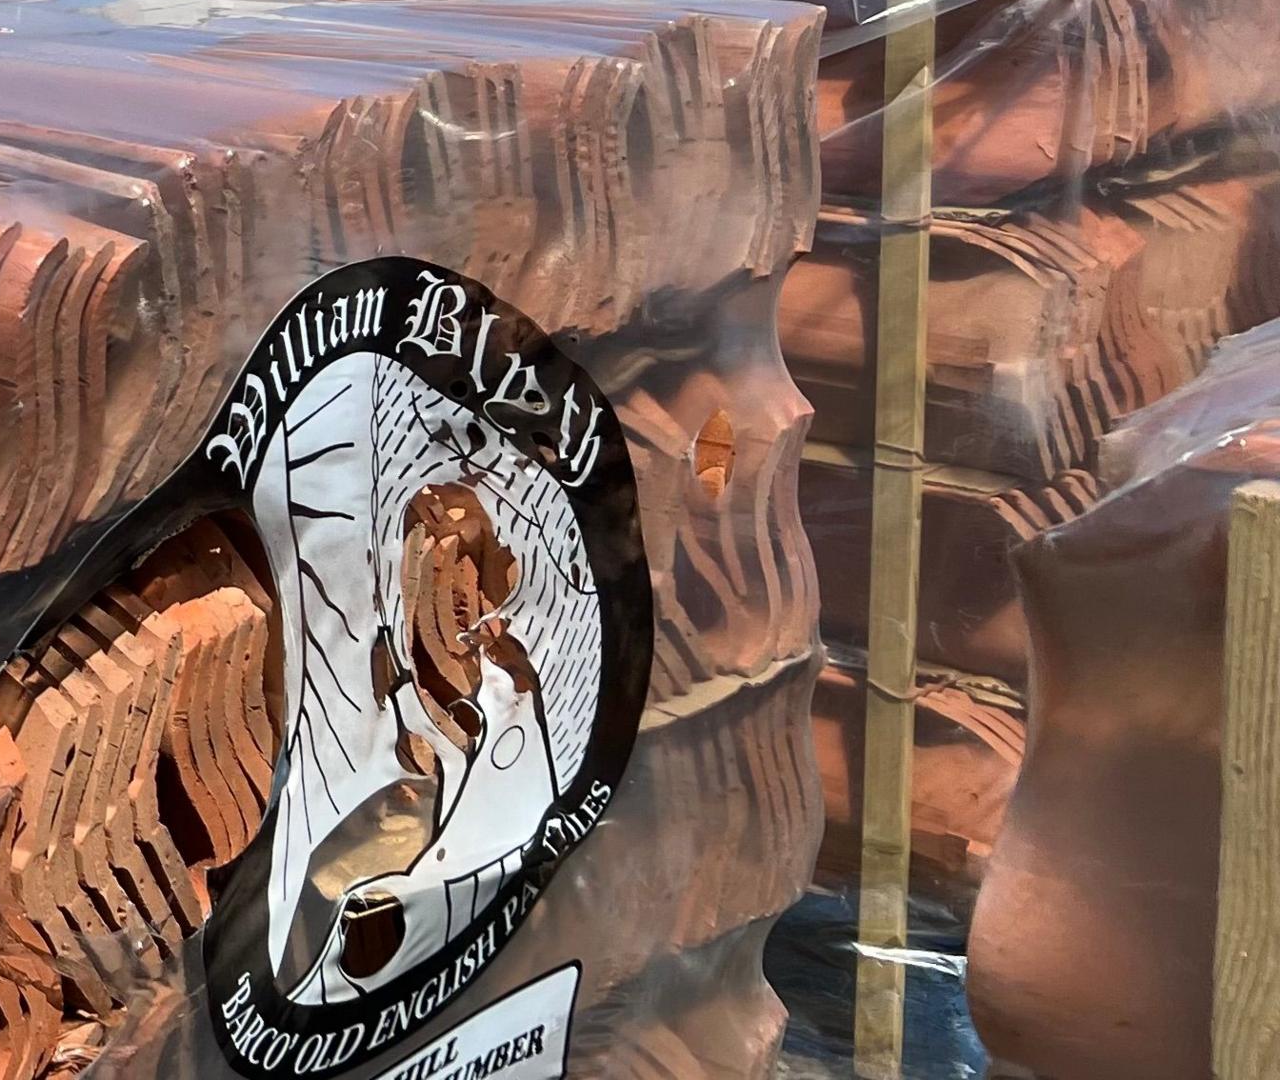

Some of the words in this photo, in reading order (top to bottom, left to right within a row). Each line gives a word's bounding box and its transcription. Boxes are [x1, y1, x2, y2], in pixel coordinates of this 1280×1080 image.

[206, 286, 389, 490] William
[395, 270, 603, 488] Blyth
[294, 1022, 366, 1075] OLD
[366, 933, 497, 1051] ENGLISH
